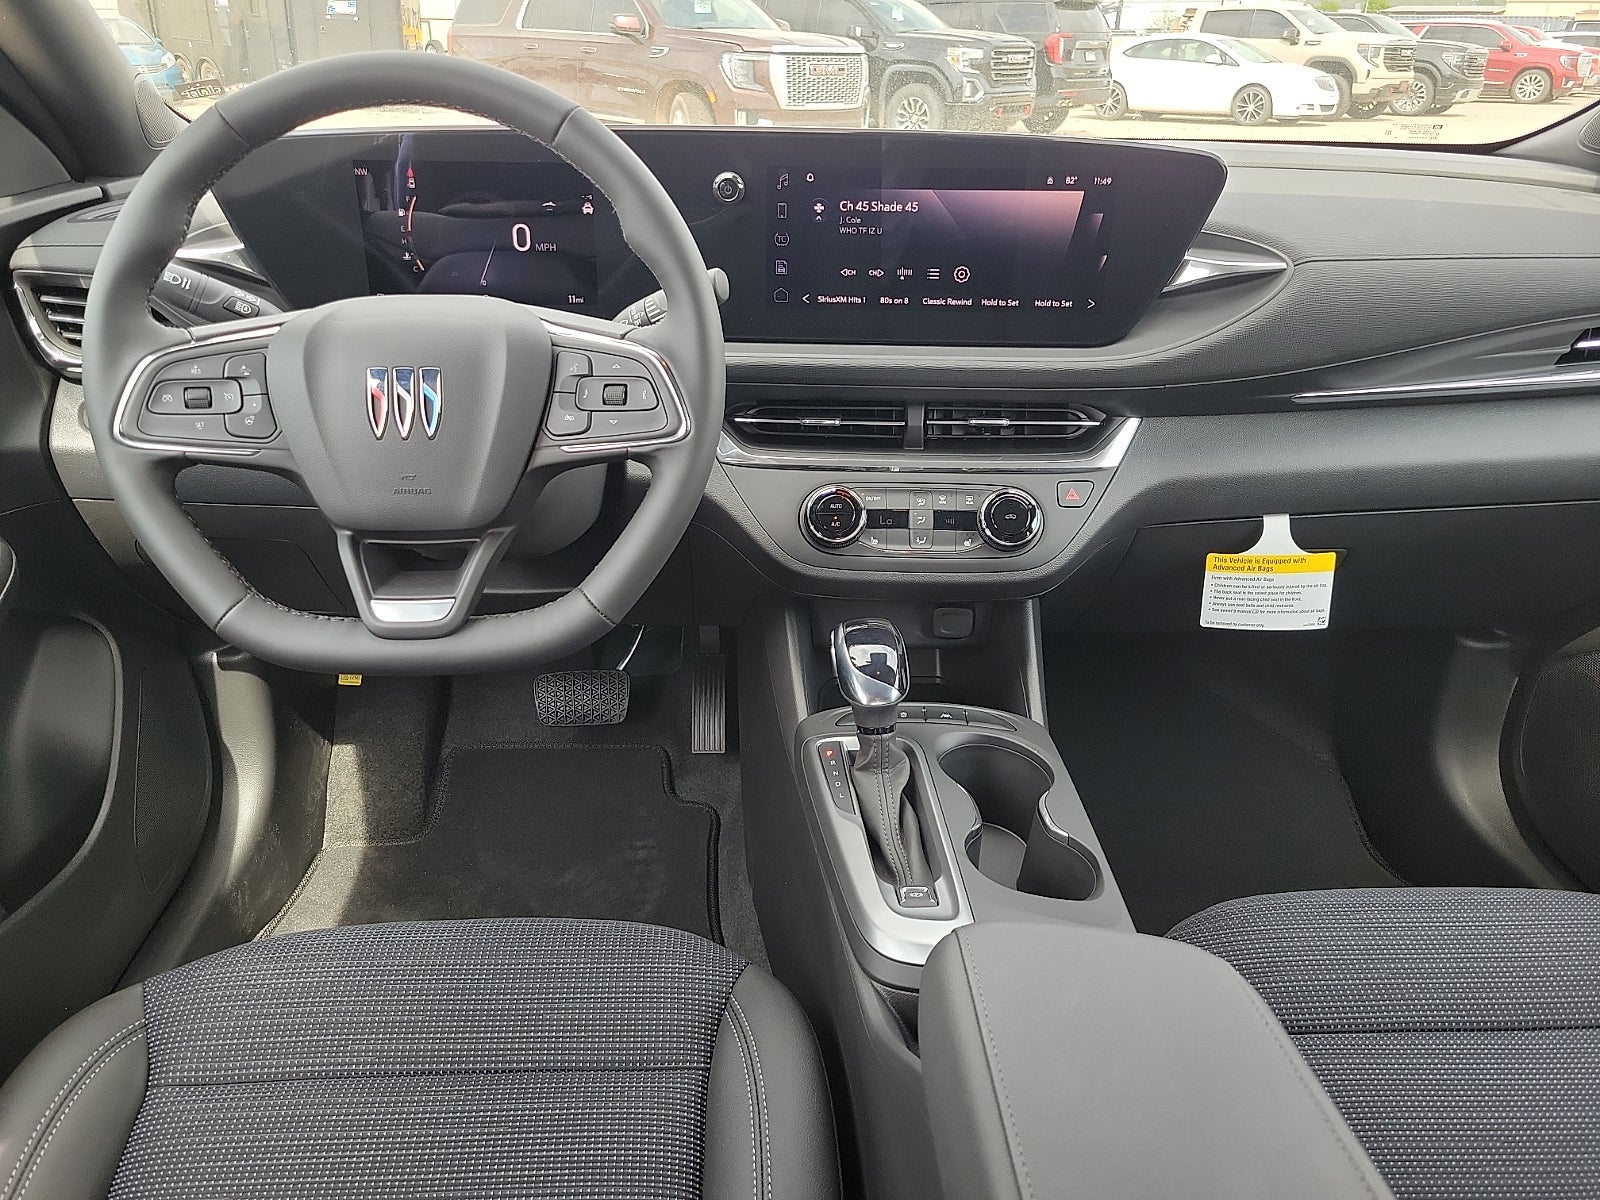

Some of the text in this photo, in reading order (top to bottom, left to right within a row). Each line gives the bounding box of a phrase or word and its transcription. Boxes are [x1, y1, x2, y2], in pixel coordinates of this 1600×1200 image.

[811, 65, 847, 75] GMC
[354, 167, 368, 175] NW
[1094, 176, 1112, 186] 11:49
[839, 200, 919, 212] Ch 45 Shade 45
[846, 216, 862, 224] Cole
[839, 227, 857, 235] WHO
[858, 227, 868, 235] TF
[877, 227, 883, 235] U
[511, 223, 532, 252] 0
[535, 243, 557, 252] MPH
[817, 295, 847, 303] SiriusXM
[922, 297, 973, 306] Classic Rewind
[1007, 299, 1019, 307] Set
[1061, 300, 1073, 308] Set
[392, 487, 432, 495] AIRBAG
[1262, 557, 1292, 566] Equipped
[1212, 563, 1246, 571] Advanced
[1257, 565, 1274, 573] Bags
